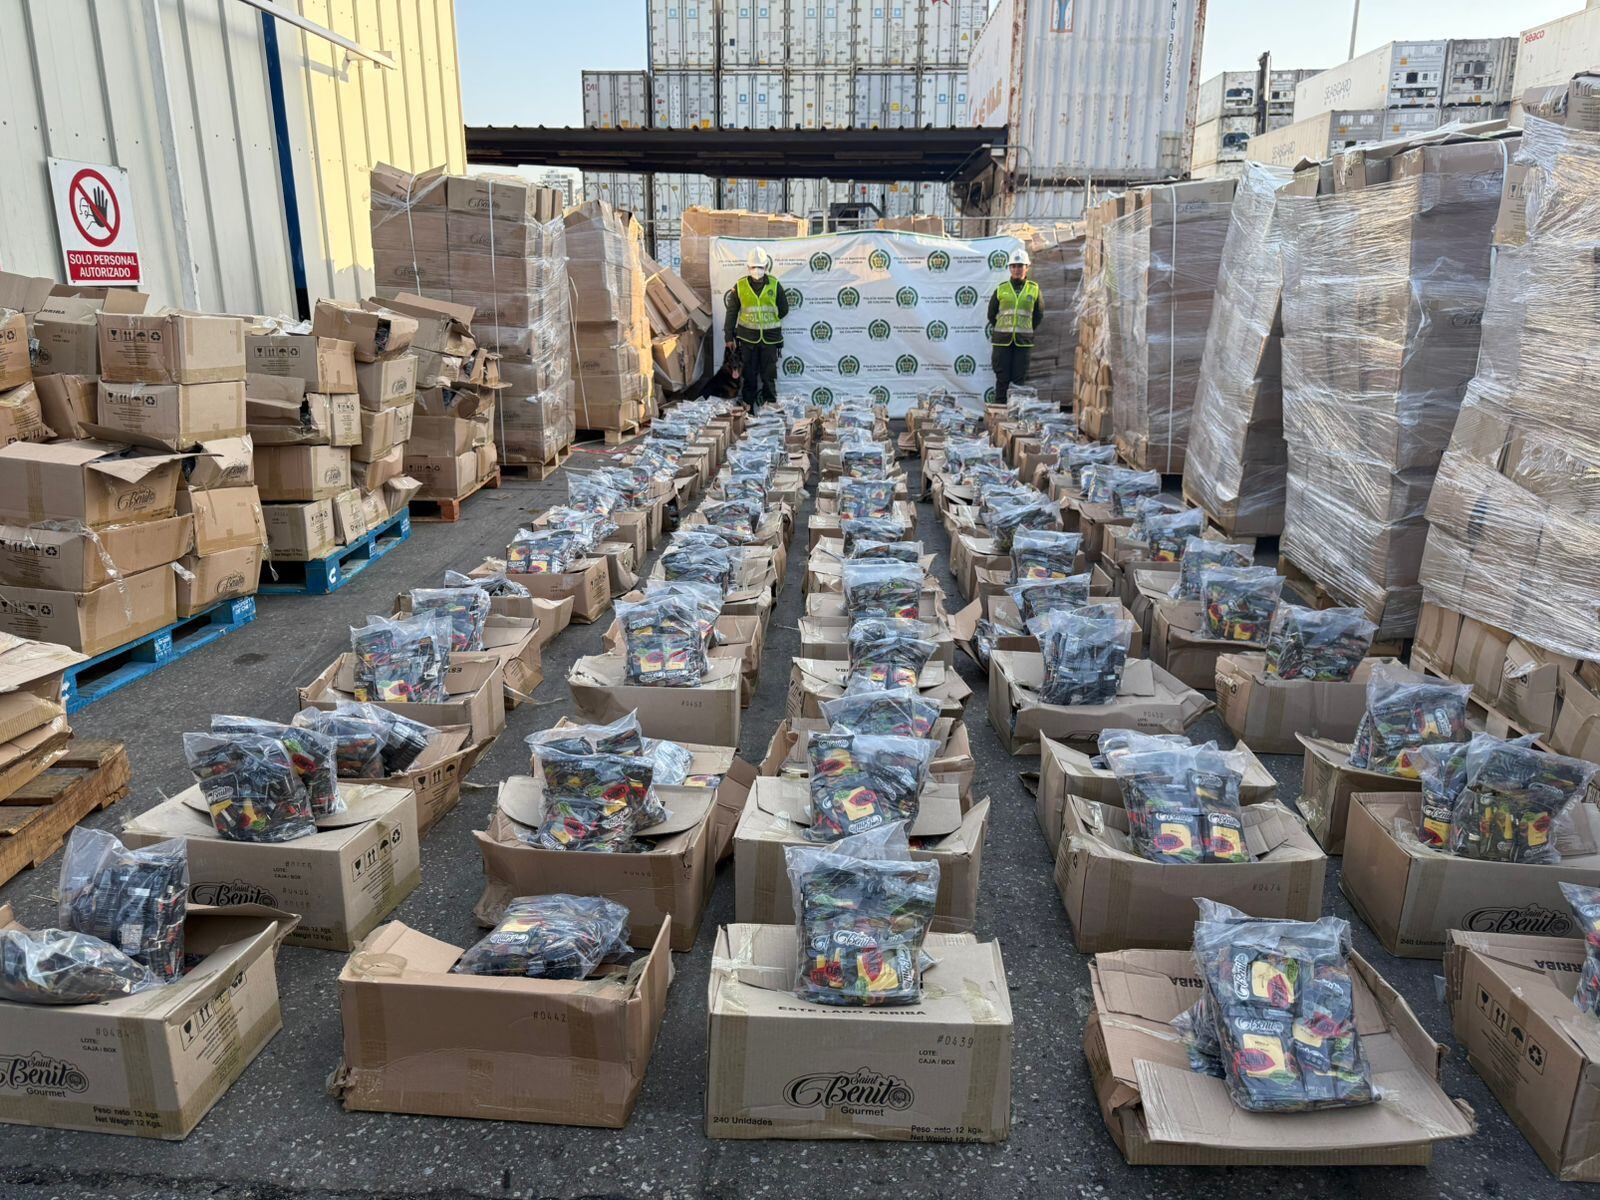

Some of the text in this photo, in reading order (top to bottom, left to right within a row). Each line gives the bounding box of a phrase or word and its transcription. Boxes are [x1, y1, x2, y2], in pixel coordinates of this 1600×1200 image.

[1524, 29, 1545, 44] seaco
[69, 254, 137, 266] SOLO PERSONAL
[80, 267, 131, 278] AUTORIZADO
[1519, 907, 1544, 919] Saint
[778, 1006, 816, 1014] ESTE
[937, 1034, 975, 1049] #0439
[28, 1056, 53, 1068] Saint
[849, 1073, 879, 1086] Saint
[26, 1087, 67, 1099] Gourmet
[790, 1075, 908, 1106] Benito
[93, 1105, 112, 1115] Peso
[133, 1110, 143, 1118] 12
[840, 1106, 885, 1117] Gourmet
[95, 1115, 108, 1124] Net
[109, 1117, 135, 1127] Weight
[136, 1119, 145, 1127] 12
[713, 1116, 773, 1127] 240 Unidades
[911, 1125, 931, 1134] Peso
[955, 1126, 965, 1134] 12
